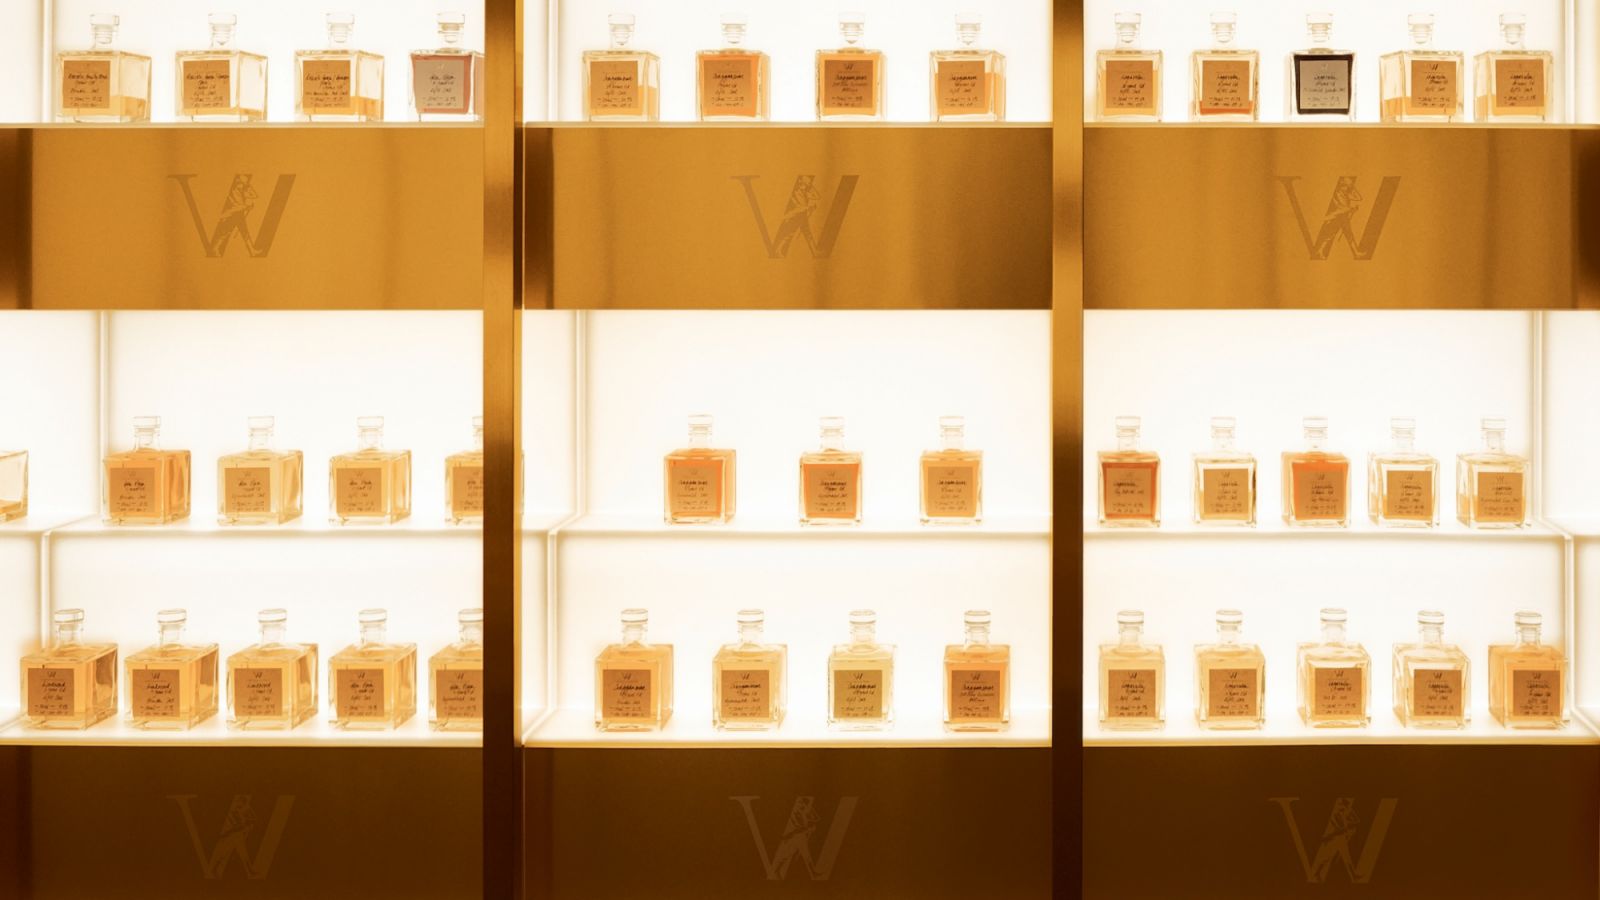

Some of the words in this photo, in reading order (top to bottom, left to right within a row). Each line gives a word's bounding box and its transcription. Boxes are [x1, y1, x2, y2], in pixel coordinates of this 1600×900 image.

[167, 173, 297, 258] W
[729, 175, 860, 259] W
[1274, 176, 1402, 260] W
[166, 794, 296, 880] W
[728, 796, 859, 880] W
[1268, 797, 1398, 883] W
